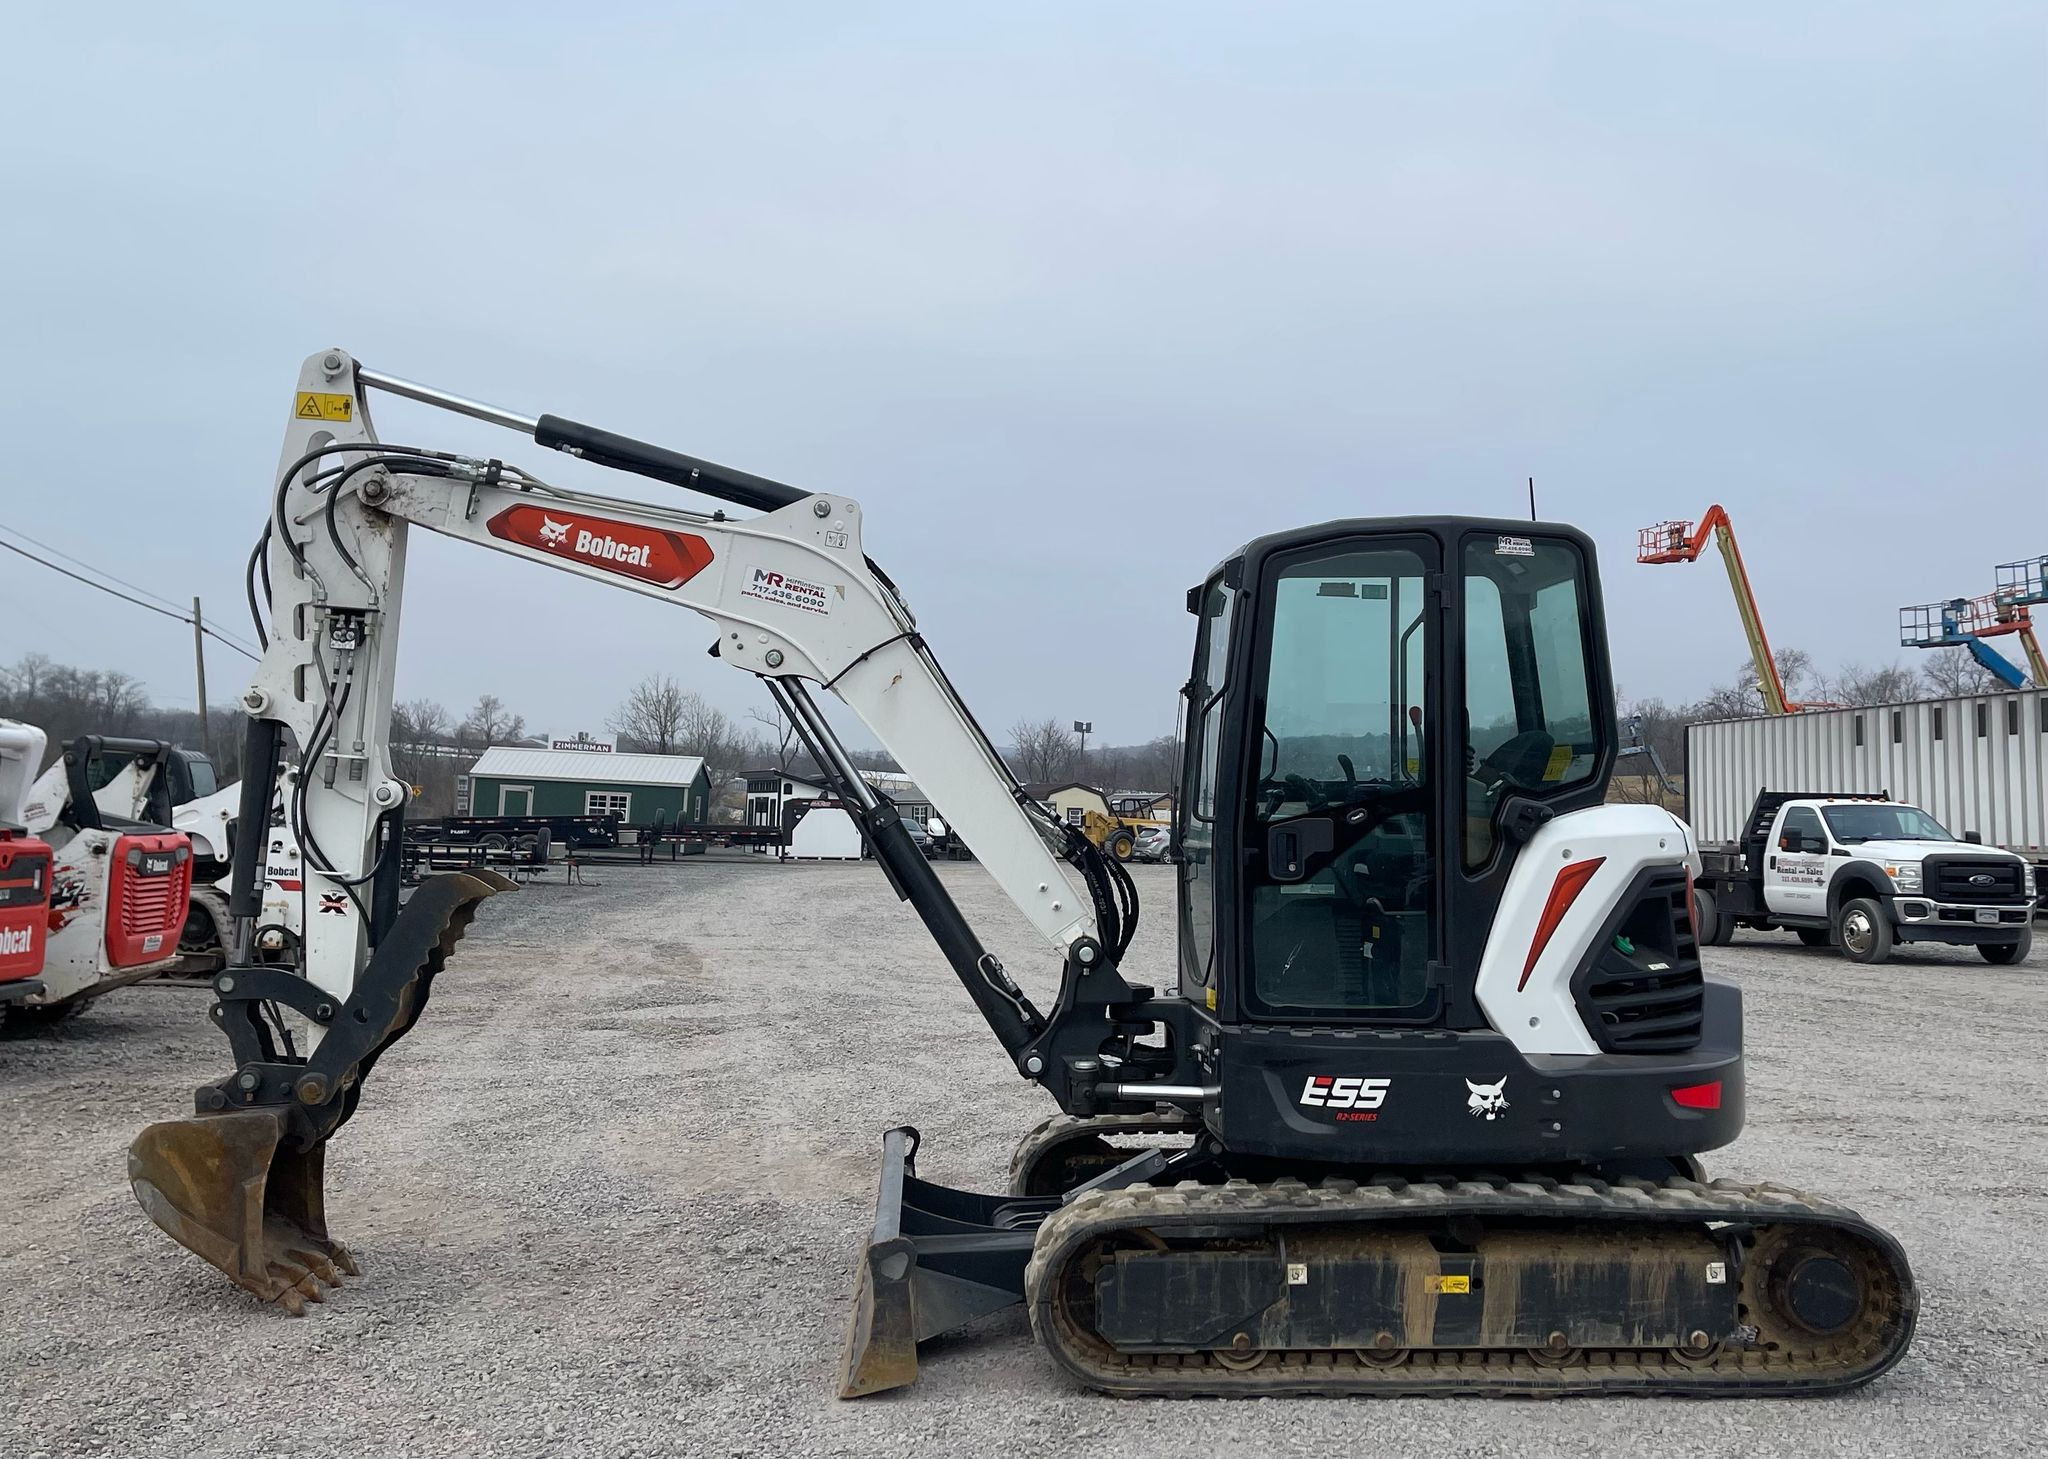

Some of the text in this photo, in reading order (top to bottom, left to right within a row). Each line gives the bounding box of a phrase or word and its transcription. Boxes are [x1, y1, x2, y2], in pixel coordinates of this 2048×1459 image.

[575, 529, 651, 568] Bobcat
[753, 568, 784, 588] MR
[786, 577, 826, 592] Mifflintown
[752, 584, 825, 608] 717.436.6090
[784, 583, 827, 599] RENTAL
[741, 589, 829, 616] parts, sales, and service
[555, 742, 609, 752] ZIMMERMAN
[267, 866, 298, 877] Bobcat
[1777, 866, 1797, 875] Rental
[1807, 867, 1823, 876] Sales
[1299, 1076, 1392, 1109] E55
